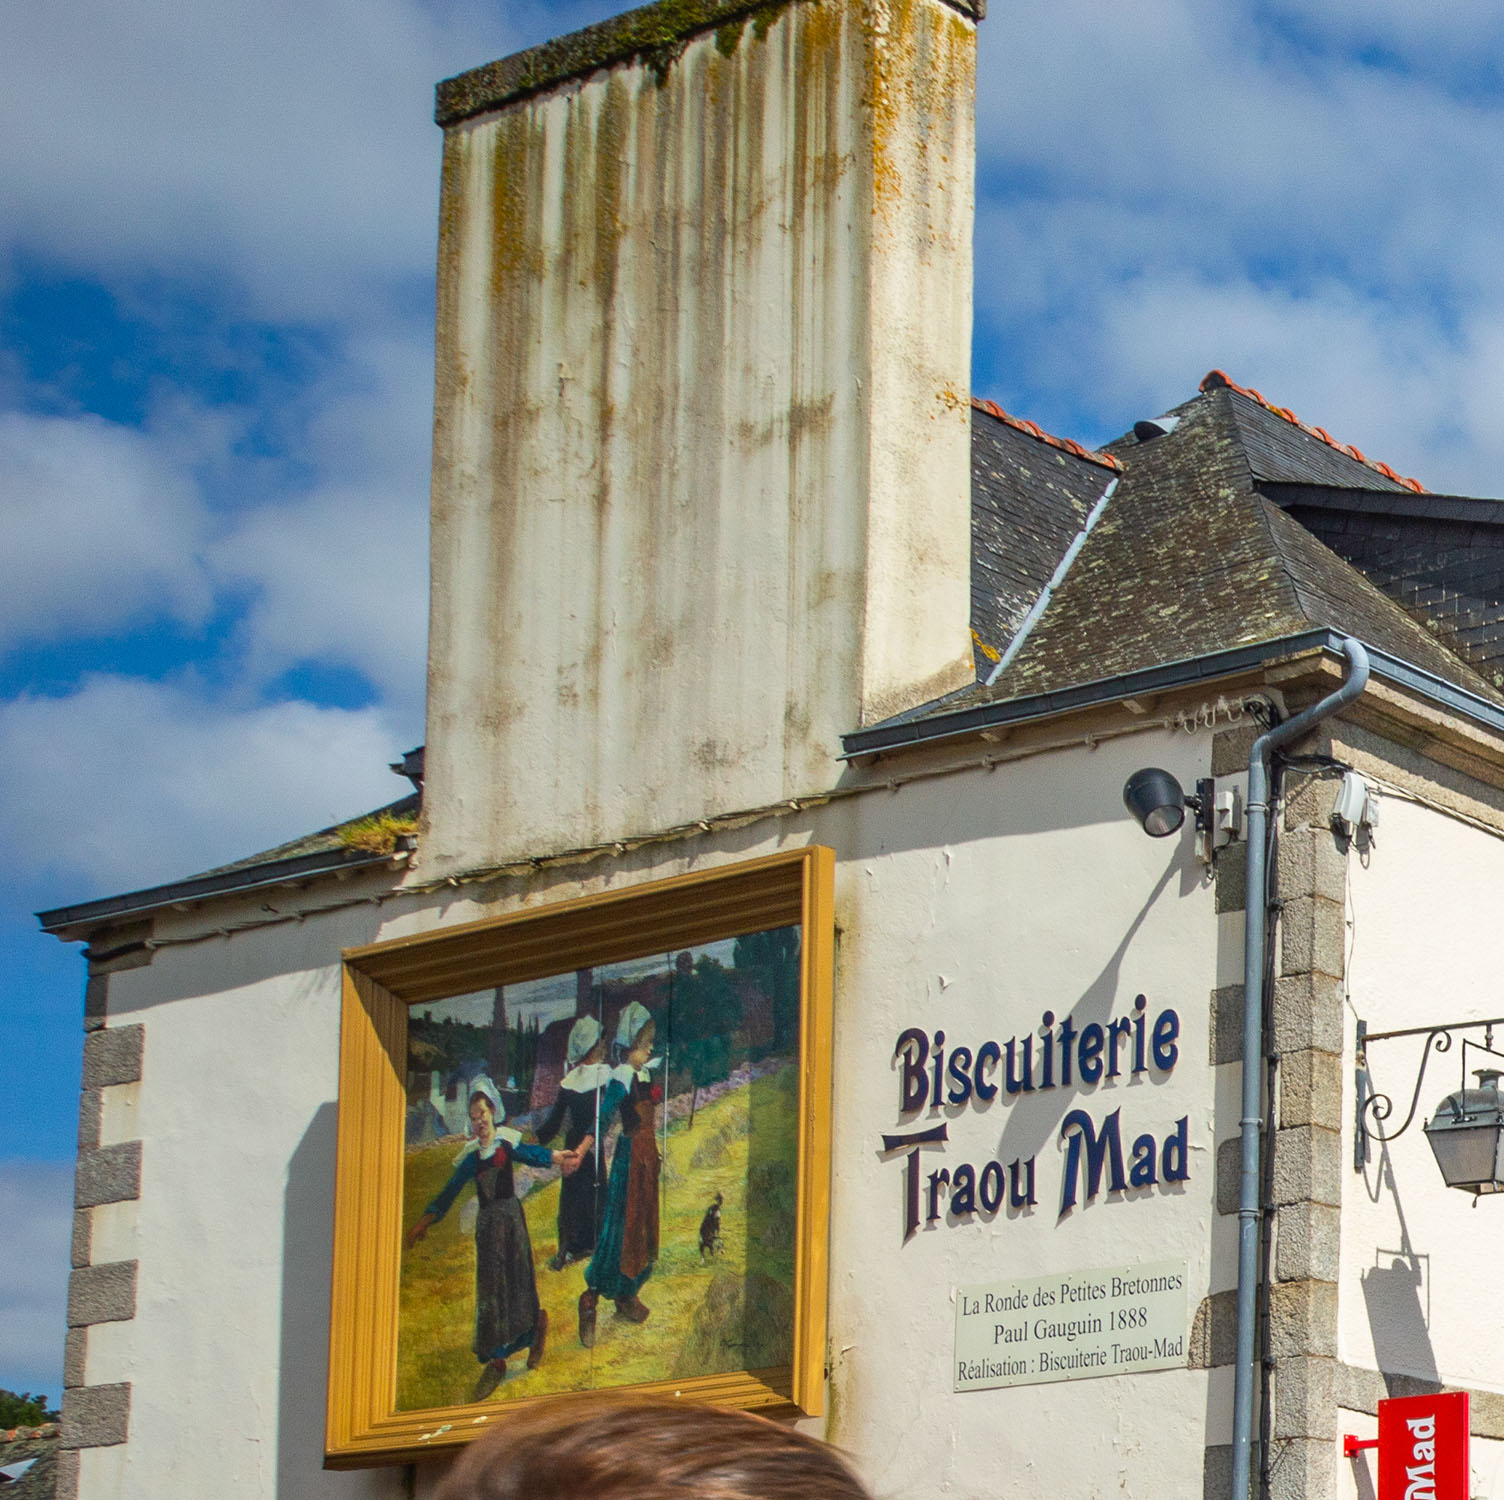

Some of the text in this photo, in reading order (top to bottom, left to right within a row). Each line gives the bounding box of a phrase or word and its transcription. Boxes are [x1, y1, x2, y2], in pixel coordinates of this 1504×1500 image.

[895, 994, 1179, 1112] Biscuiterie
[882, 1105, 1190, 1247] Traou Mad
[963, 1273, 1183, 1316] La Ronde des Petites Bretonnes
[994, 1306, 1148, 1345] Paul Gauguin 1888
[958, 1358, 1027, 1381] Réalisation
[1039, 1346, 1107, 1372] Biscuiterie
[1111, 1335, 1183, 1364] Traou-Mad
